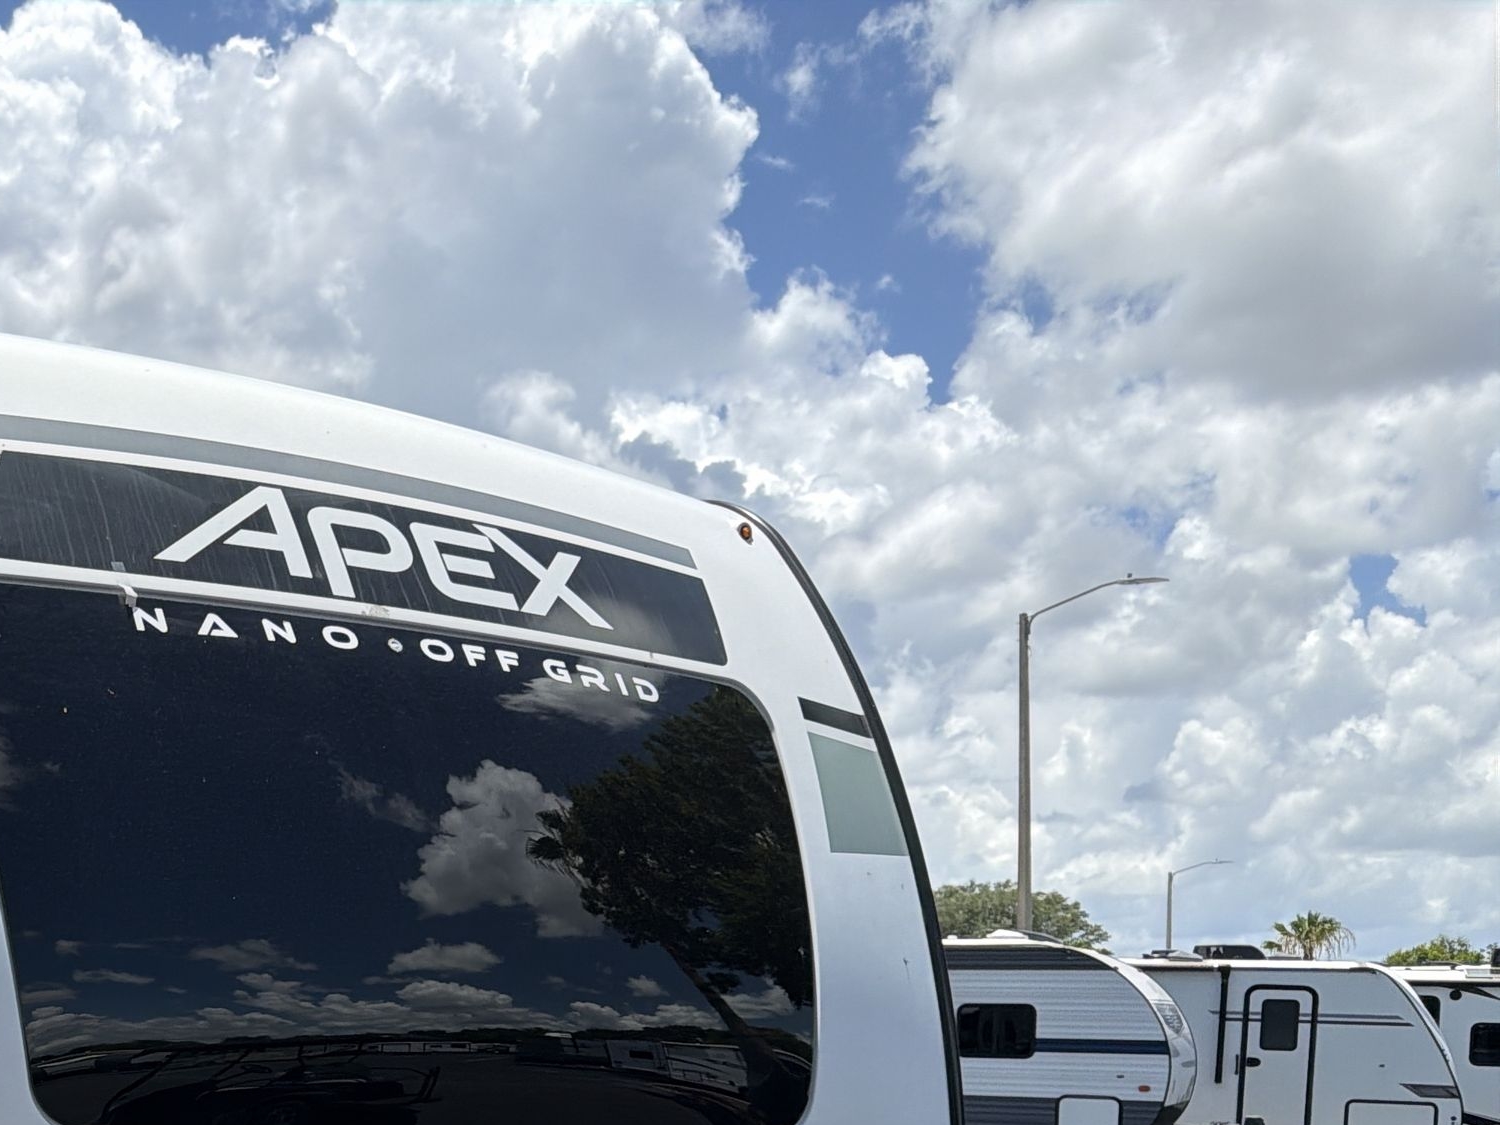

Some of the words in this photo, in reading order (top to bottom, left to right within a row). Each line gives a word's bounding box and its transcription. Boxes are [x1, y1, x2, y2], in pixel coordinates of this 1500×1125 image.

[153, 485, 613, 631] APEX
[133, 607, 359, 651] NANO
[420, 638, 520, 673] OFF
[543, 658, 659, 703] GRID
